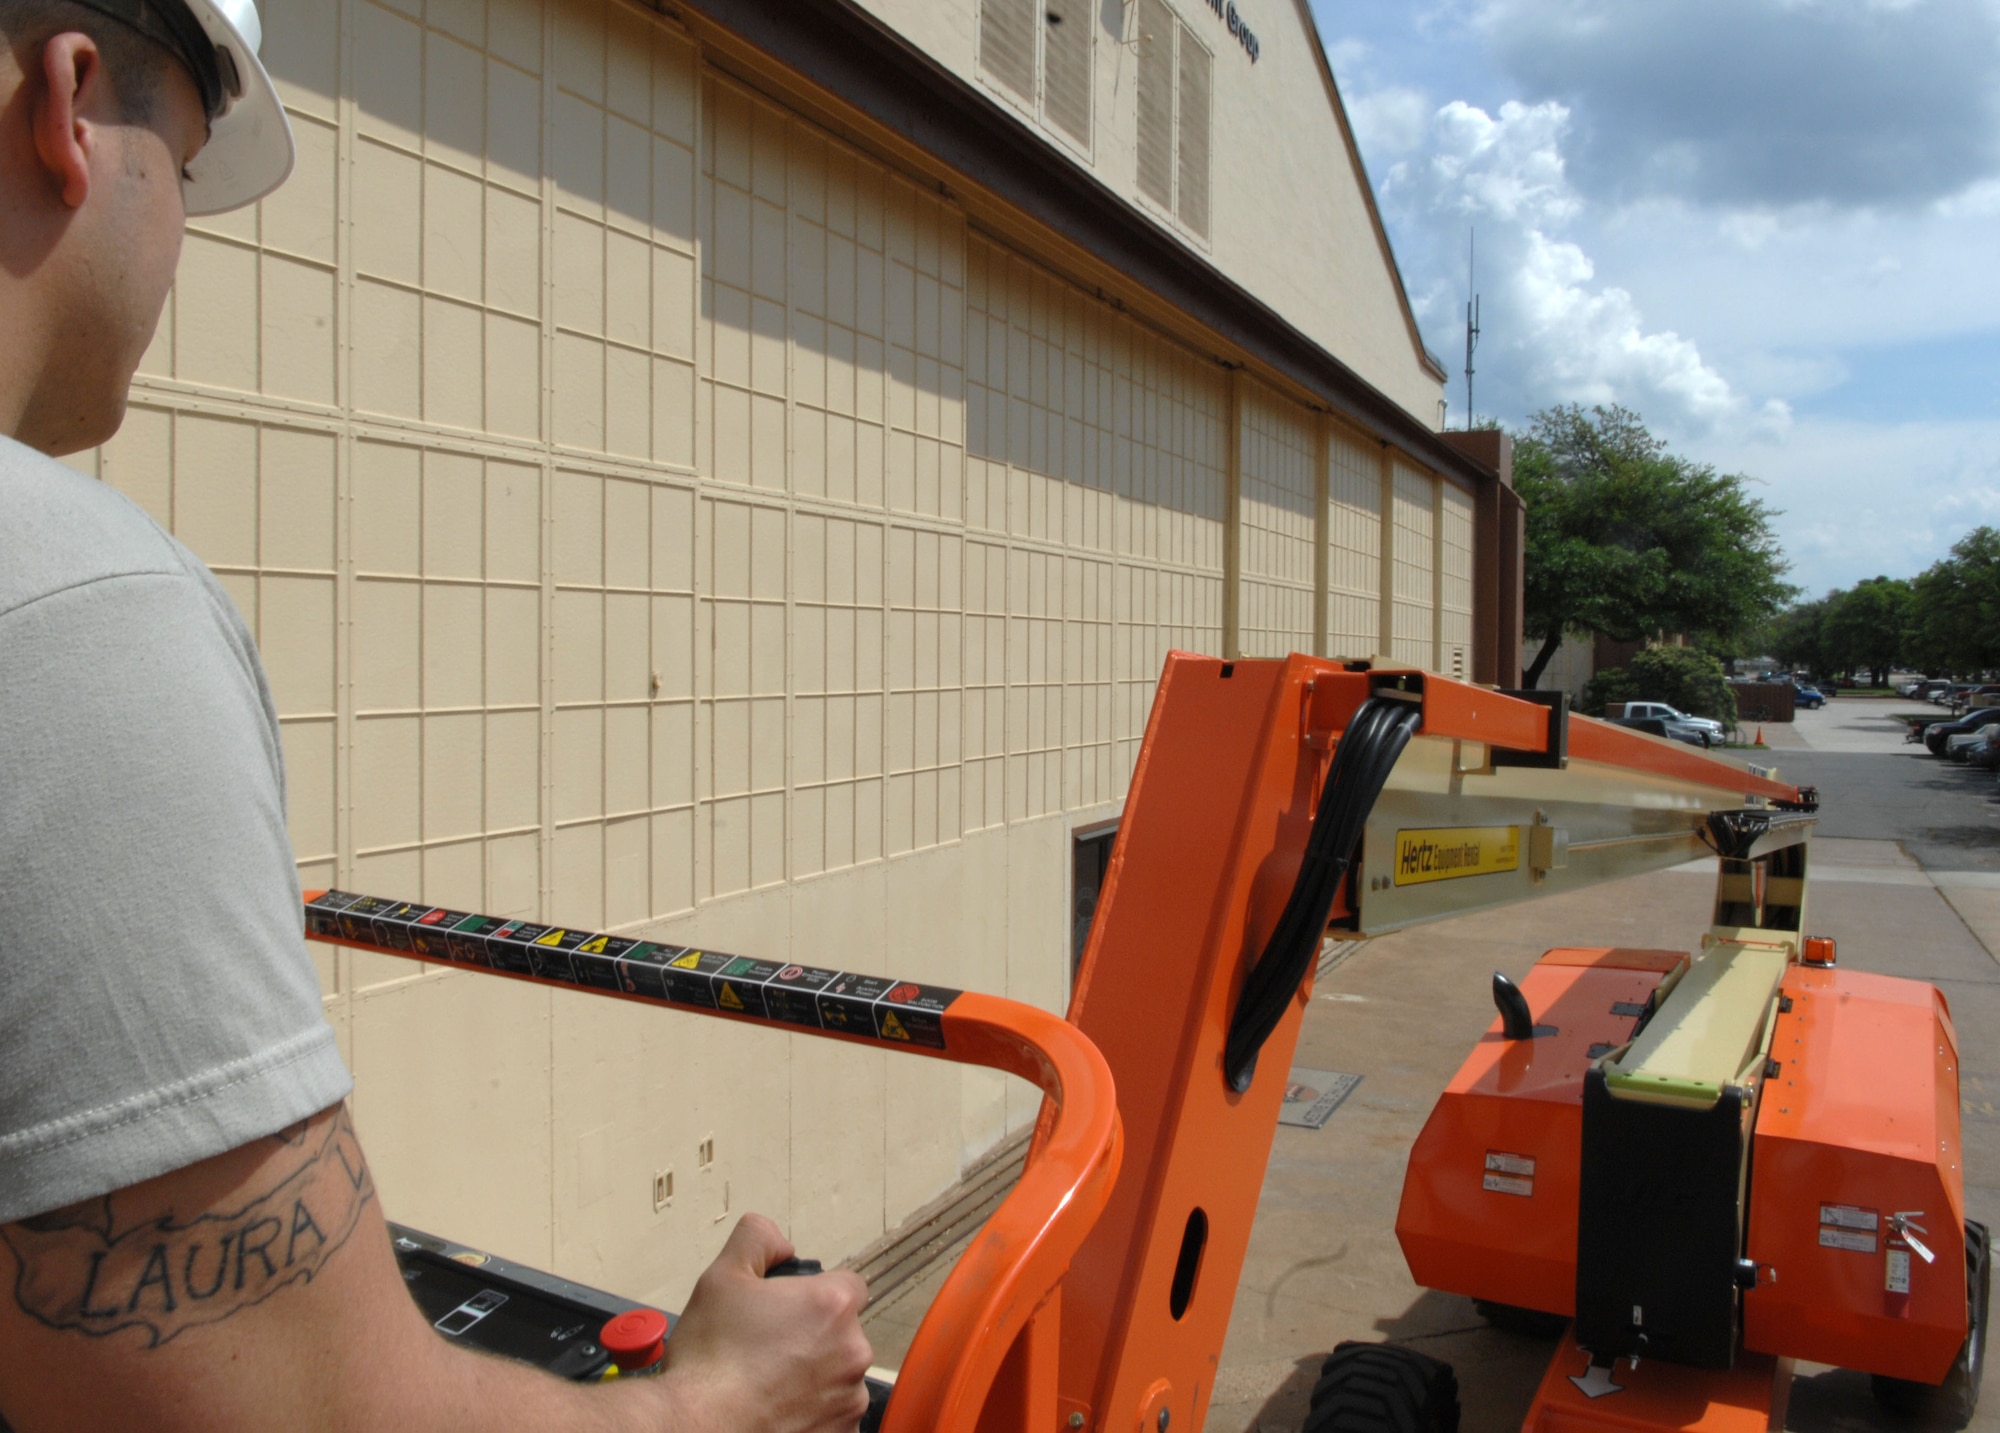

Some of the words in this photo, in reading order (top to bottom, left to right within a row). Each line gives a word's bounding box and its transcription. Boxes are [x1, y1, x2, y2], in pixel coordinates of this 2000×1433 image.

[1226, 1, 1260, 65] Group
[1401, 840, 1433, 875] Hertz
[1434, 844, 1463, 874] Equipment
[79, 1199, 327, 1318] LAURA
